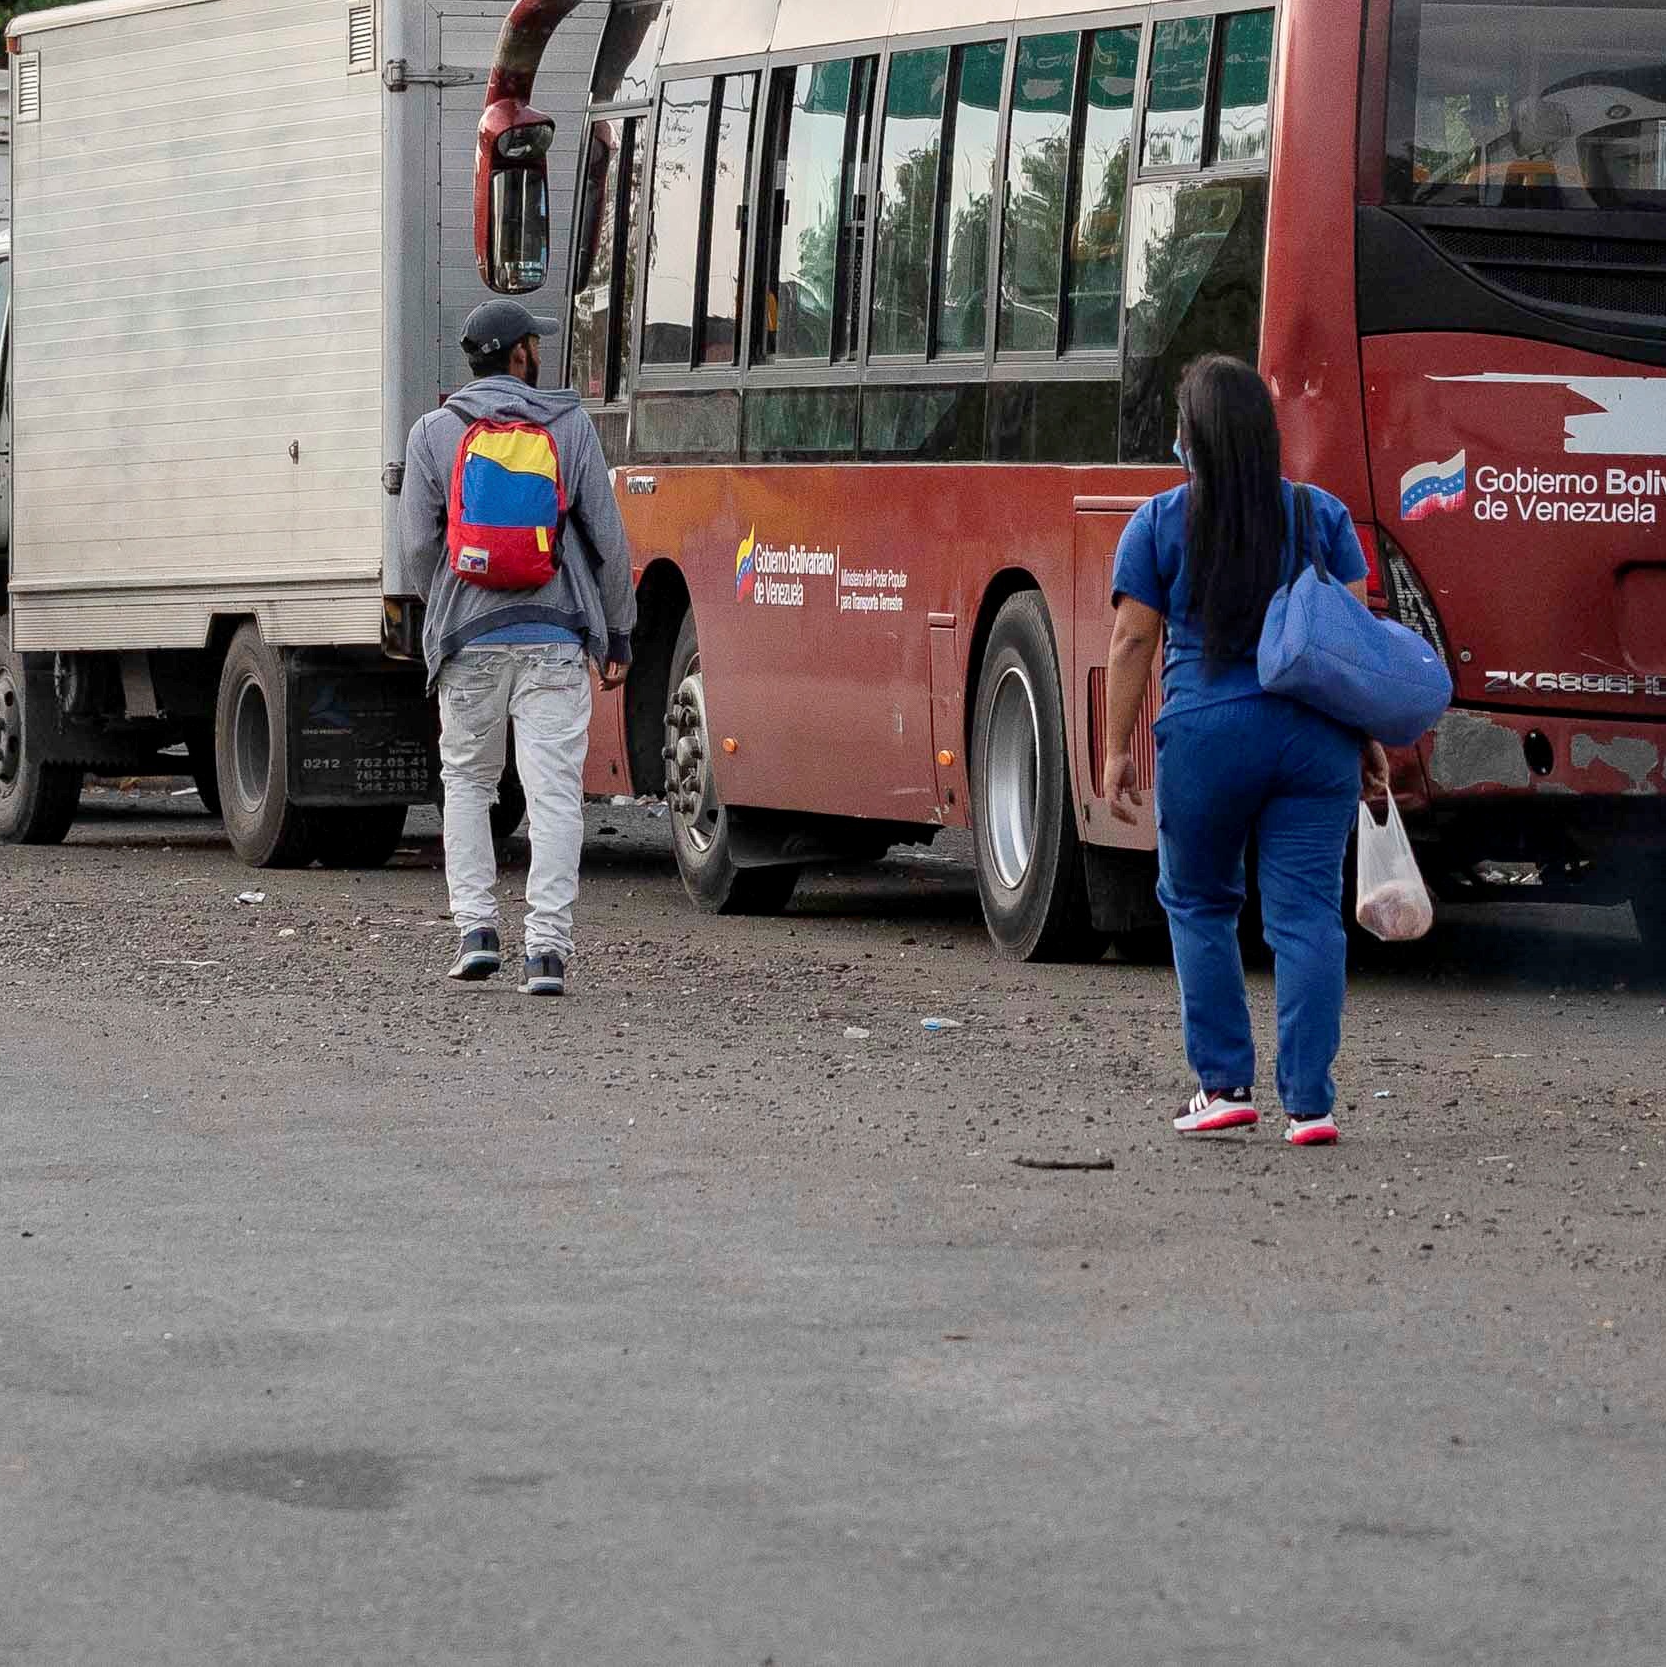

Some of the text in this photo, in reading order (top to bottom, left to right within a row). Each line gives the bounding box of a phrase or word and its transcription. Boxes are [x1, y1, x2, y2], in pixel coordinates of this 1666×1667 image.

[1474, 465, 1598, 495] Gobierno
[1473, 495, 1656, 524] de Venezuela
[754, 543, 834, 576] Gobierno Bolivariano
[754, 576, 804, 606] de Venezuela
